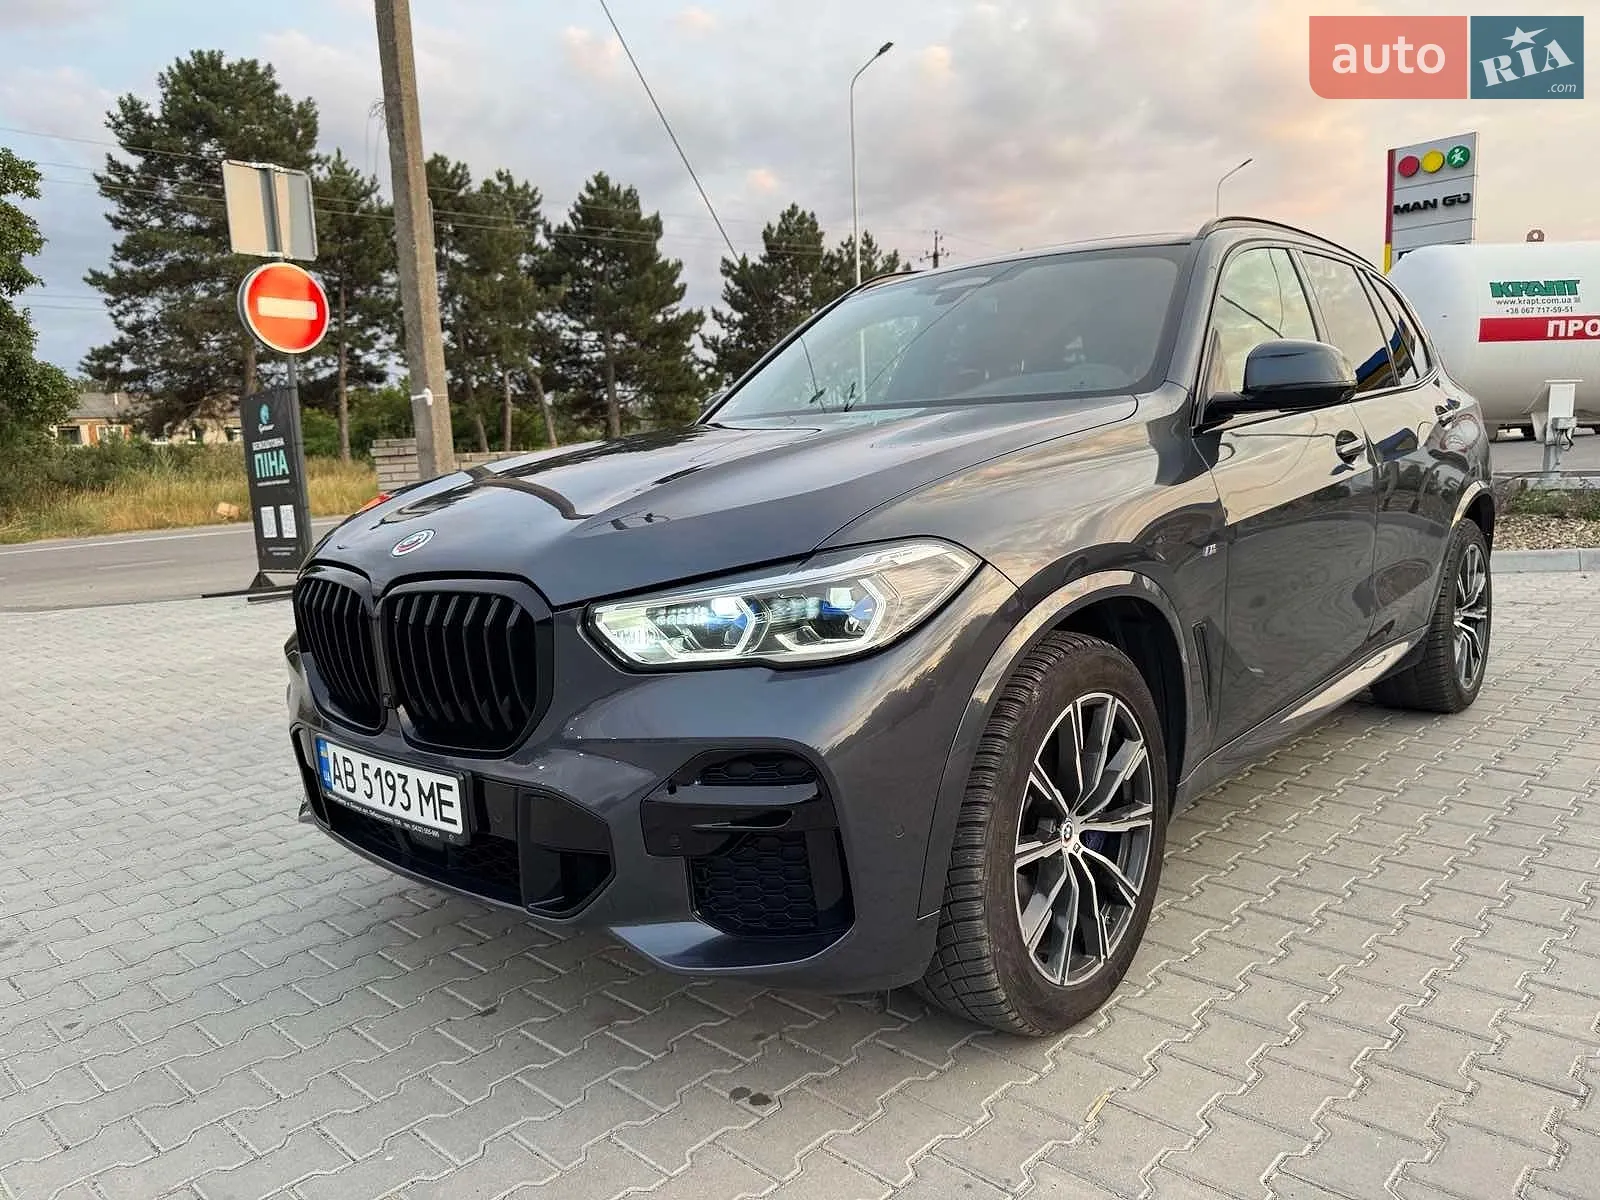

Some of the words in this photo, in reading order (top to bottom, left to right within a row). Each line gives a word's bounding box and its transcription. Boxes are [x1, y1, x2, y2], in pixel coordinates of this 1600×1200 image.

[1393, 198, 1438, 214] MAN
[1496, 297, 1571, 306] www.krapt.com.ua
[1521, 306, 1534, 314] 067
[1537, 305, 1573, 313] 717-59-51
[1547, 318, 1600, 338] ПРО
[254, 449, 290, 478] ПІНА
[332, 752, 356, 793] AB
[361, 762, 412, 811] 5193
[416, 777, 458, 825] ME
